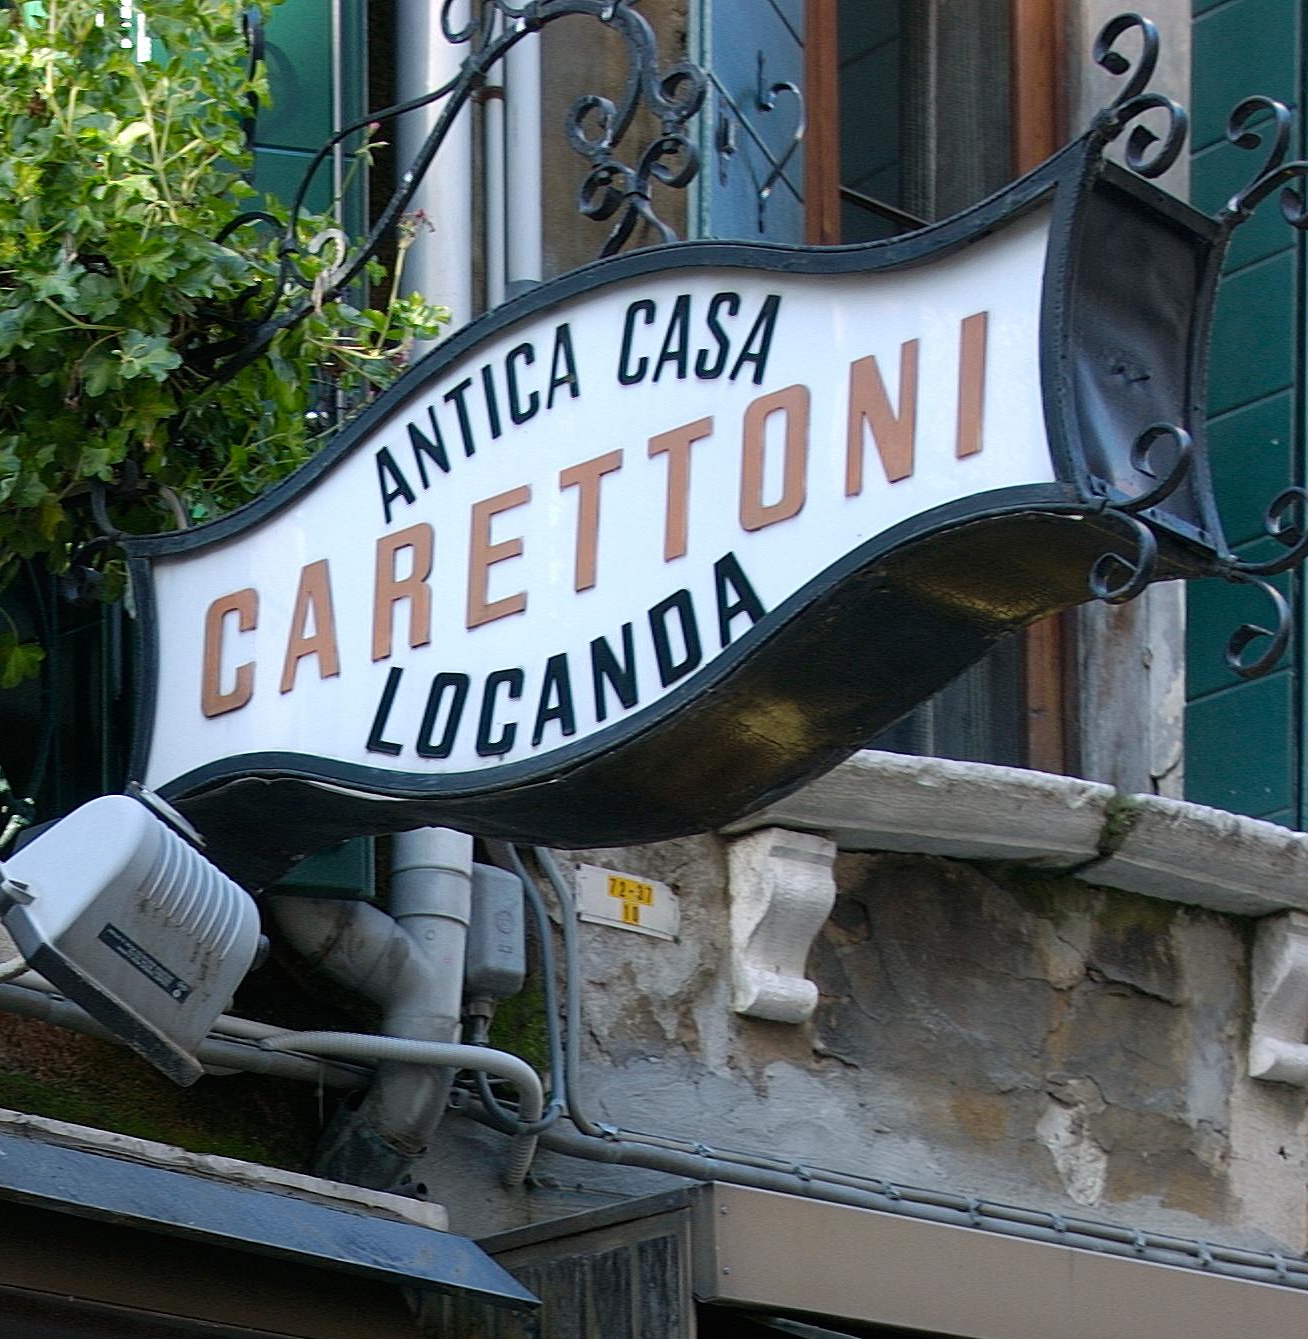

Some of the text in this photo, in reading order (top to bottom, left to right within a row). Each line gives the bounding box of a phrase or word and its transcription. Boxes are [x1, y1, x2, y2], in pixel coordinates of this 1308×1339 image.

[199, 310, 989, 719] CARETTONI
[376, 290, 782, 523] ANTICA CASA
[365, 550, 765, 759] LOCANDA
